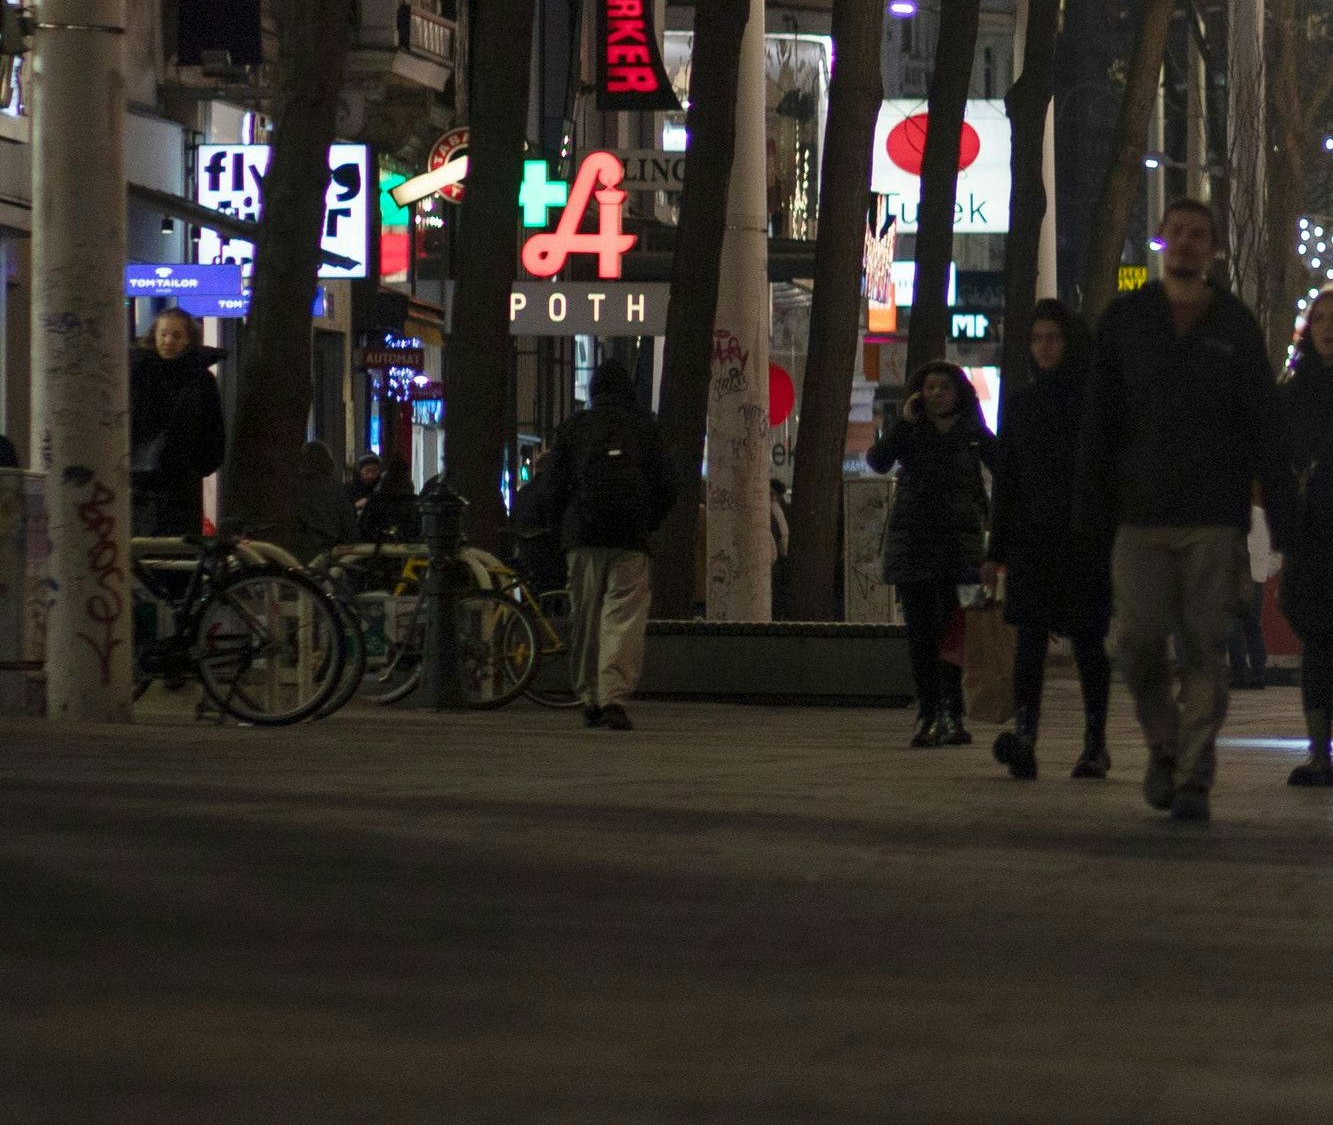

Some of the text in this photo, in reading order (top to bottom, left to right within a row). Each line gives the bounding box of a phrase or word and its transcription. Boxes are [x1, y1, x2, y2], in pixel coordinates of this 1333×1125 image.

[129, 278, 199, 289] TOM TAILOR
[365, 352, 421, 366] AUTOMAT
